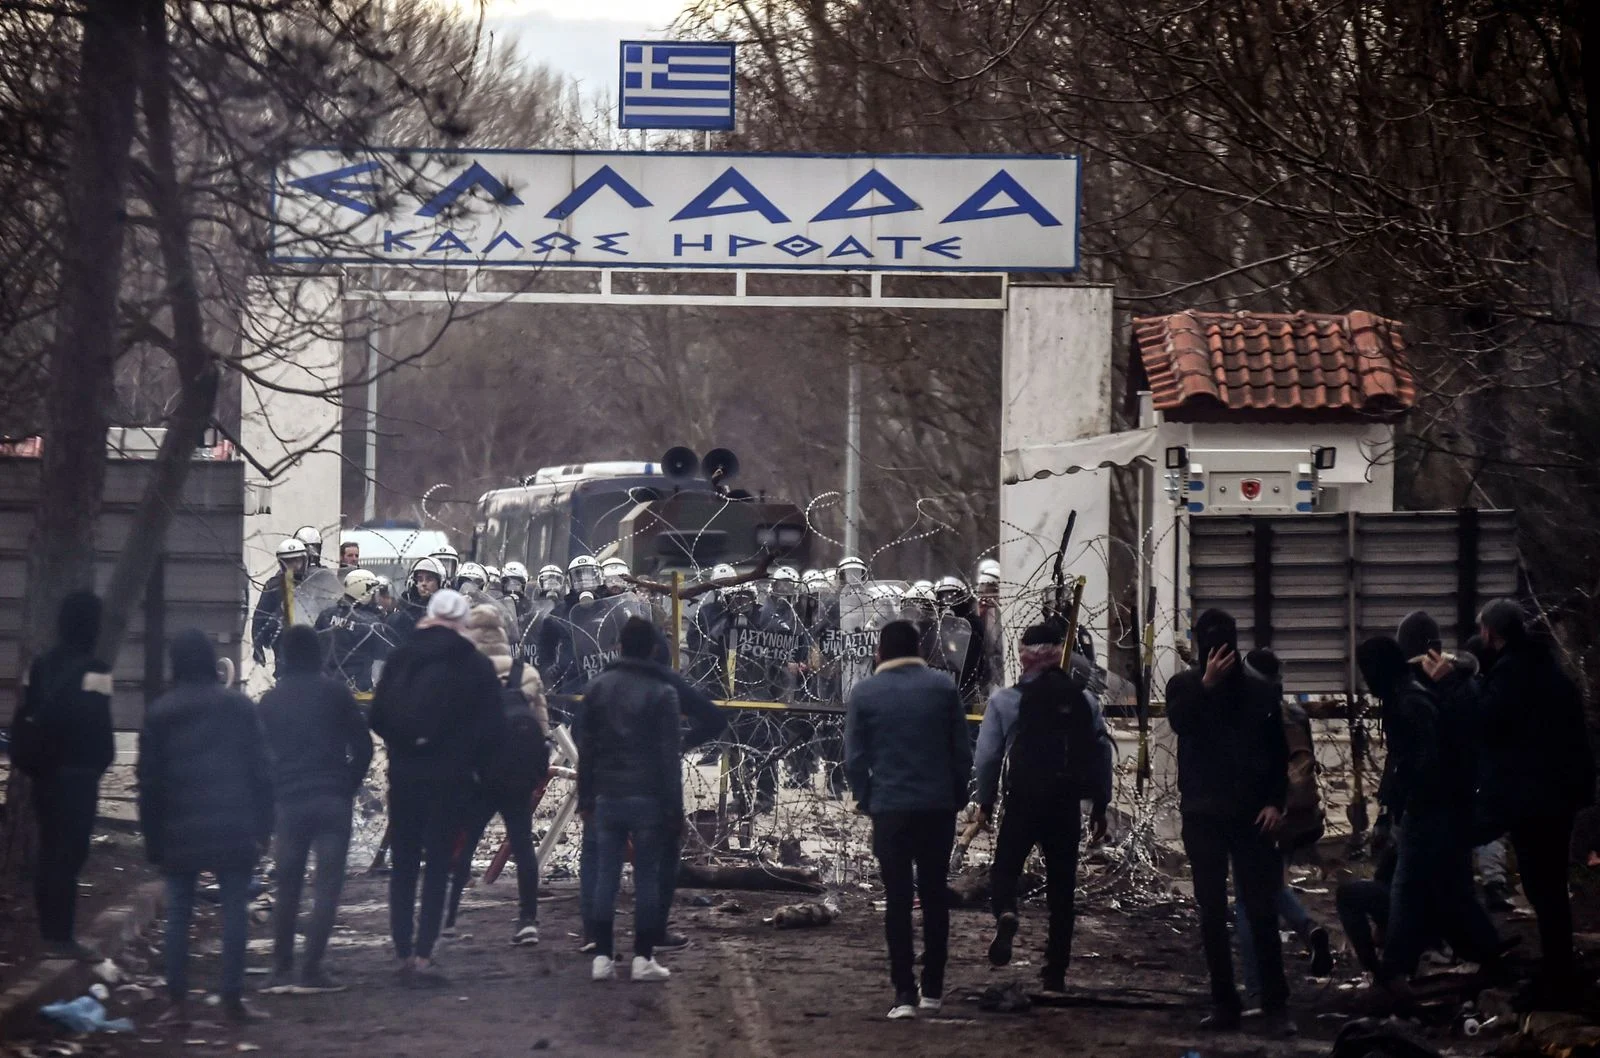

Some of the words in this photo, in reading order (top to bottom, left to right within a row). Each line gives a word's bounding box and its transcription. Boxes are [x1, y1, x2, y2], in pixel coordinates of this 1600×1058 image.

[286, 159, 1062, 227] ΕΛΛΑΔΑ
[384, 230, 630, 255] ΚΑΛΩΣ
[673, 233, 963, 260] ΗΡΘΑΤΕ
[739, 629, 799, 650] ΑΣΤΥΝΟΜΙΑ
[845, 631, 881, 650] ΑΣΤΥΝ
[583, 650, 620, 670] ΑΣΤΥΝ
[741, 644, 796, 662] POLICE
[848, 645, 874, 660] POL
